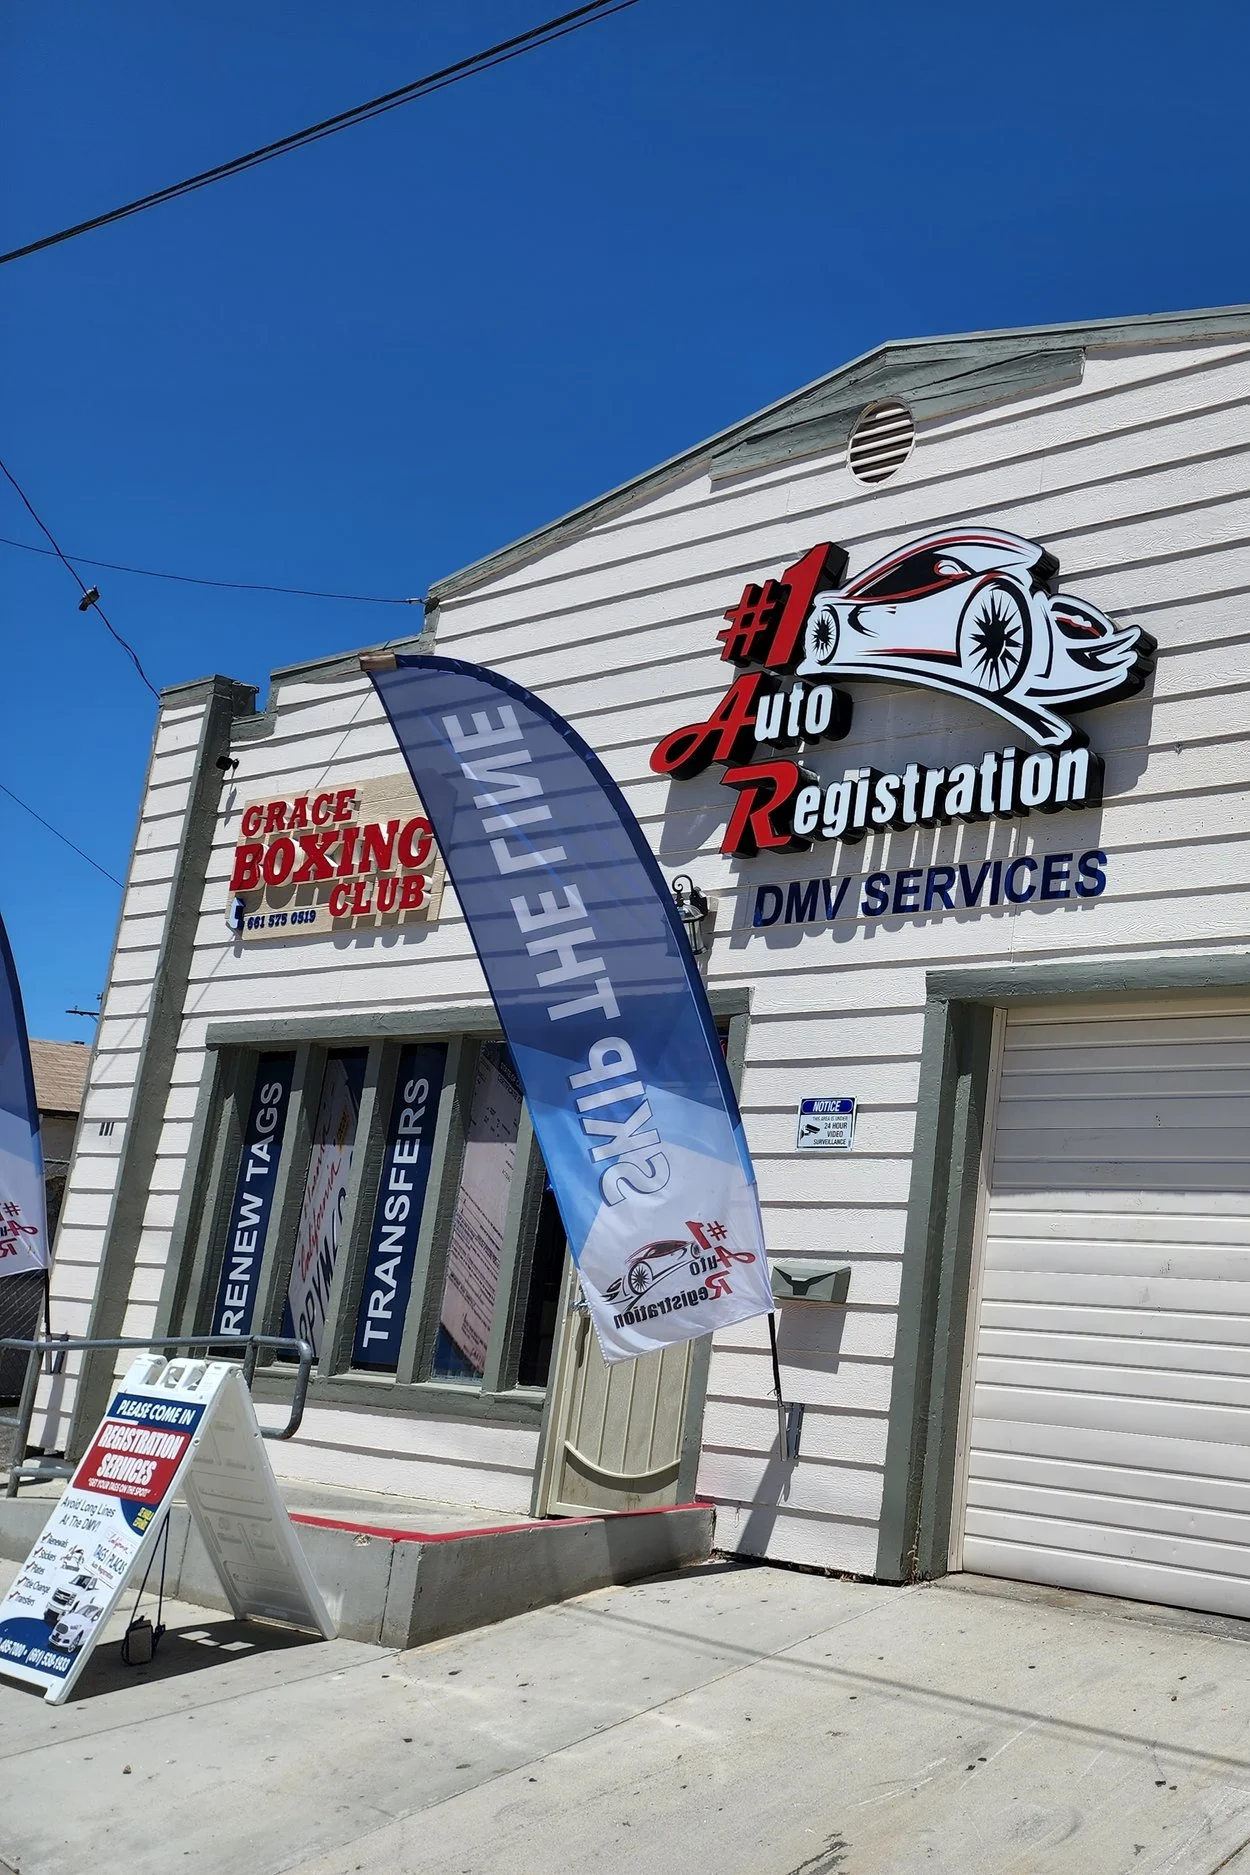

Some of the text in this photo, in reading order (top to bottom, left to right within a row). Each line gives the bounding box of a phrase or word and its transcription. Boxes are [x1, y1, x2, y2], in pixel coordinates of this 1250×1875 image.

[716, 541, 832, 668] #1
[649, 672, 833, 776] Auto
[241, 788, 357, 838] GRACE
[719, 747, 1089, 856] Registration
[229, 816, 434, 891] BOXING
[329, 874, 426, 917] CLUB
[753, 850, 1108, 928] DMV SERVICES
[247, 909, 317, 930] 661 575 0519
[812, 1100, 841, 1112] NOTICE
[219, 1082, 283, 1336] RENEW TAGS
[362, 1077, 430, 1348] TRANSFERS
[117, 1399, 196, 1426] PLEASE COME IN
[97, 1424, 185, 1460] REGISTRATION
[96, 1452, 157, 1486] SERVICES
[60, 1513, 69, 1525] At
[69, 1515, 82, 1529] The
[61, 1496, 117, 1518] Avoid Long Lines
